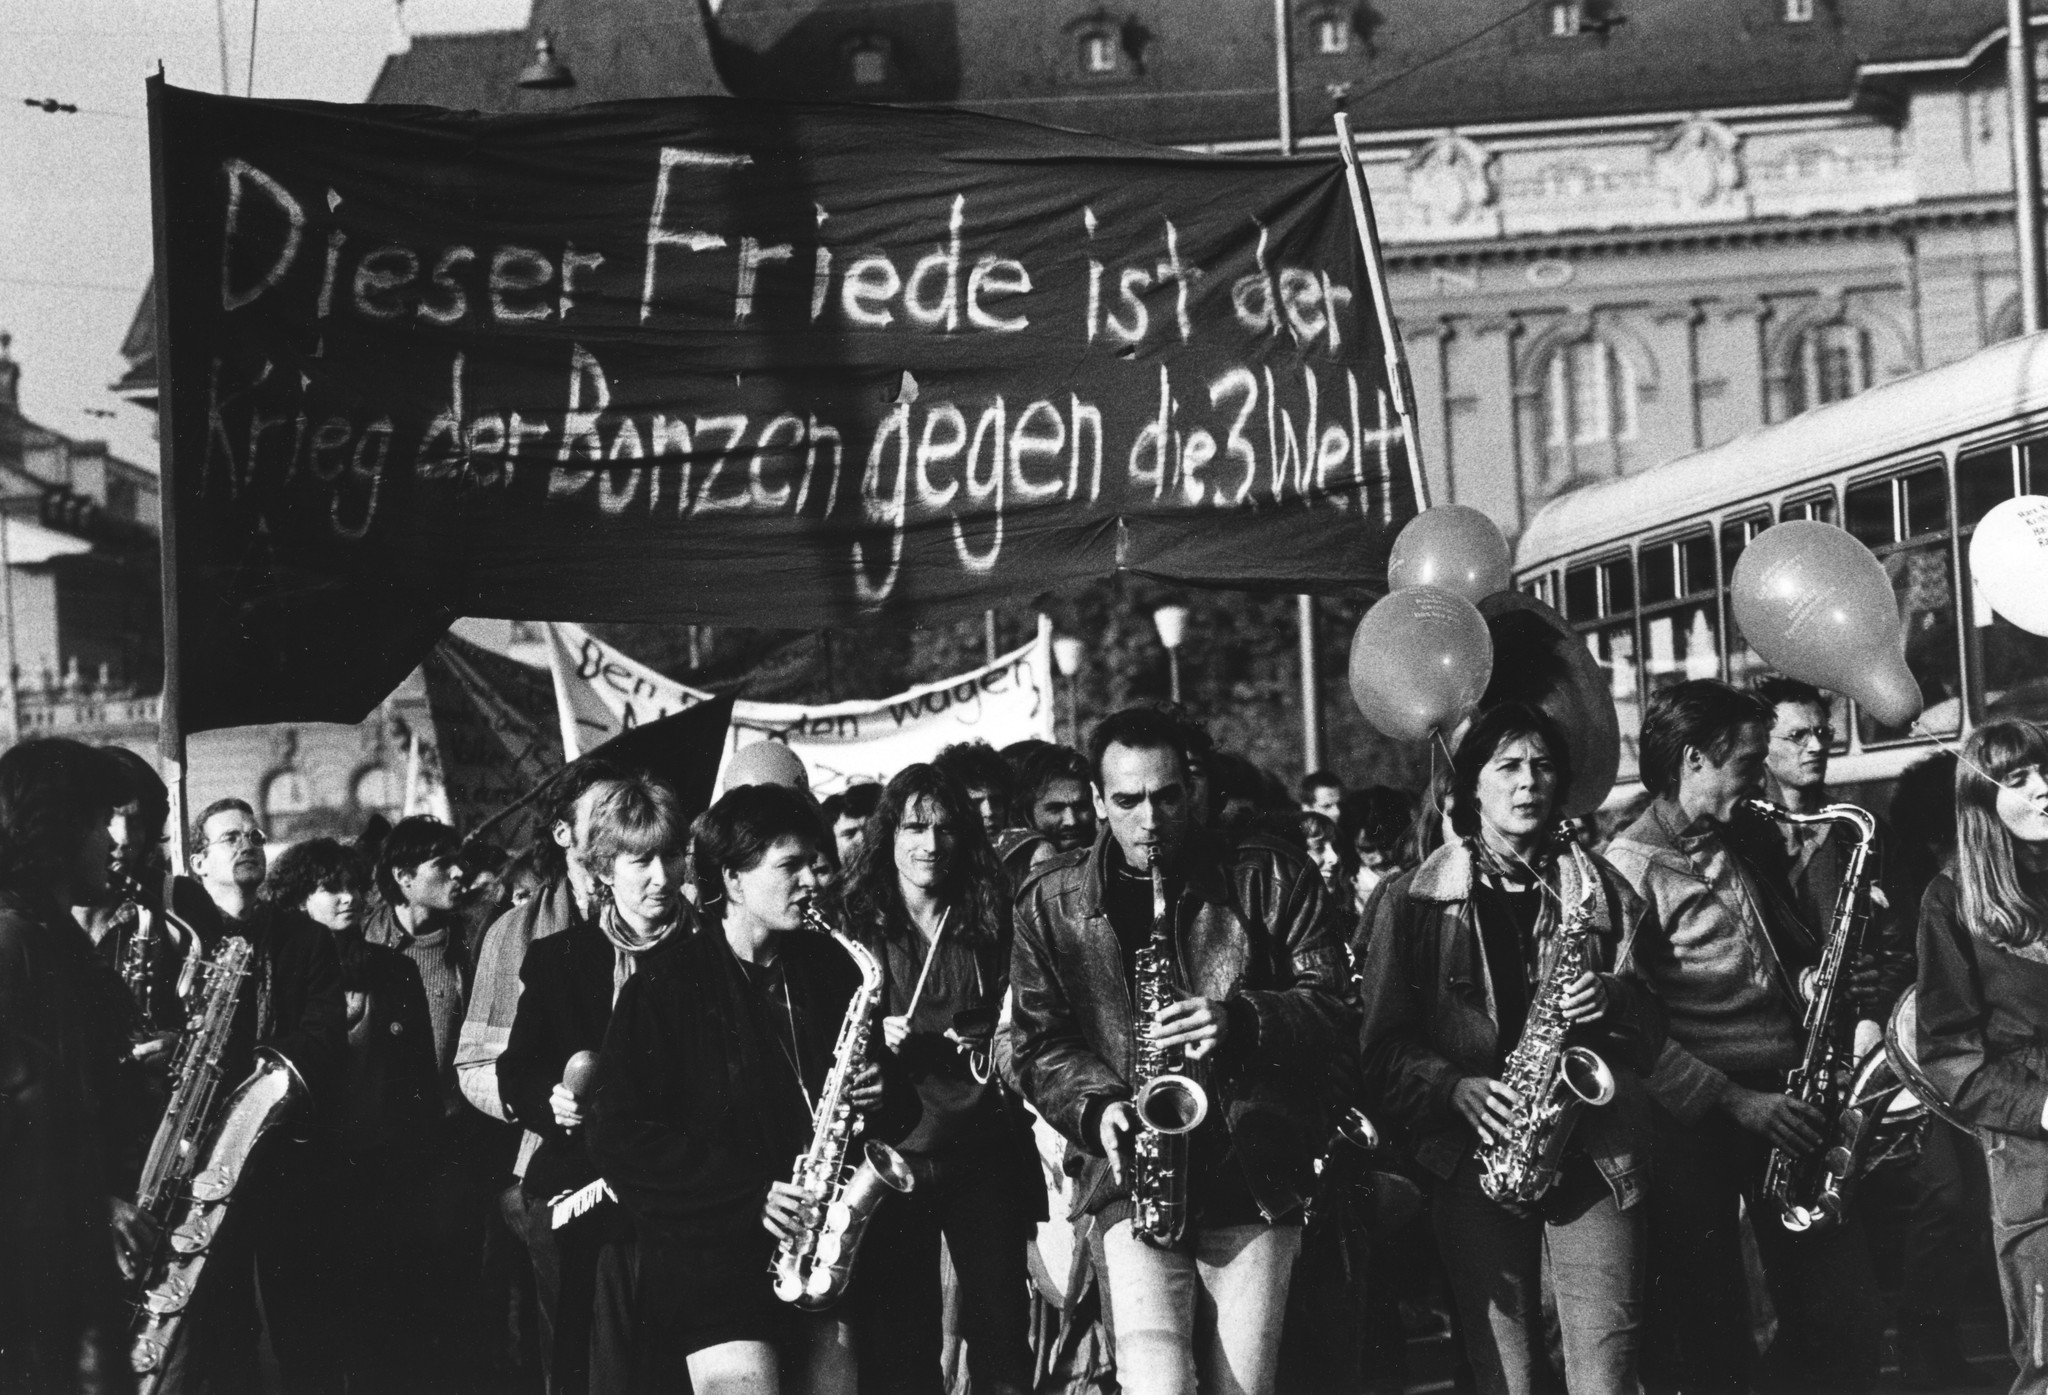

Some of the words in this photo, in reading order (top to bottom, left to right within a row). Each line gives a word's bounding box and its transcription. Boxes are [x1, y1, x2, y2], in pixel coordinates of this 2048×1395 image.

[220, 157, 605, 323] Dieser
[639, 146, 1034, 333] Friede
[1083, 205, 1203, 344] ist
[1231, 214, 1353, 353] der
[199, 356, 396, 539] Krieg
[416, 351, 551, 487] der
[853, 394, 1103, 612] gegen
